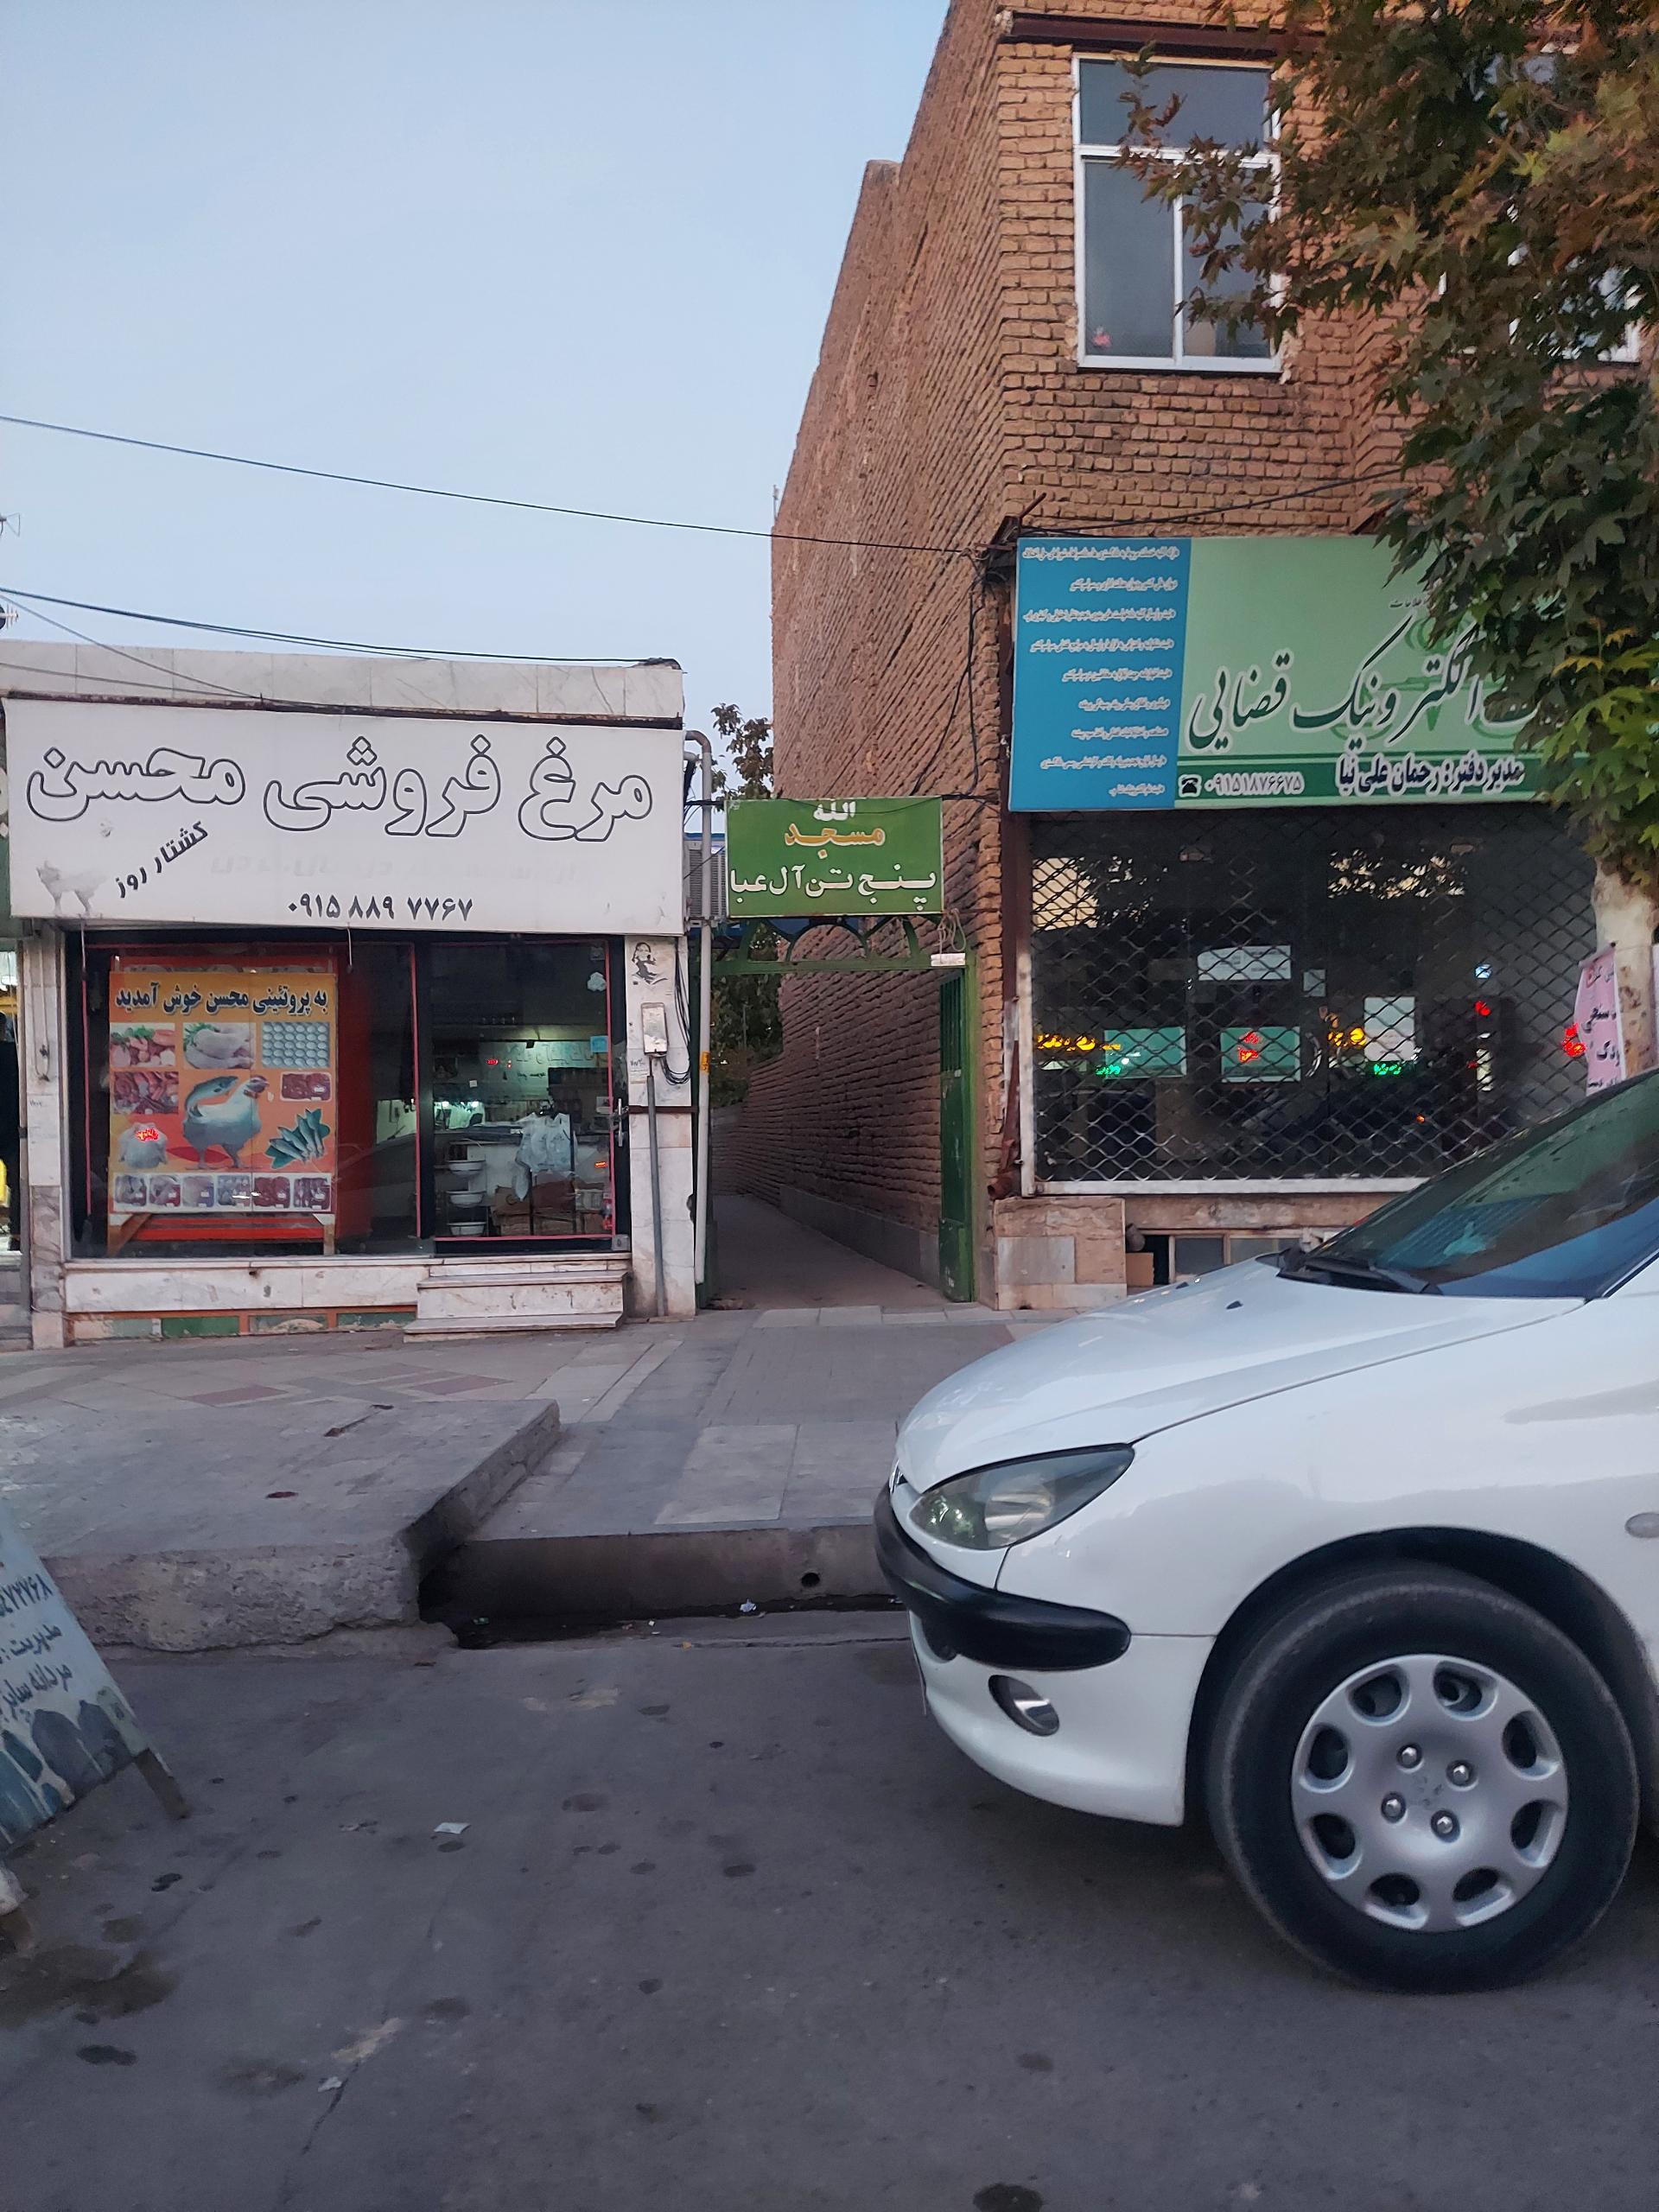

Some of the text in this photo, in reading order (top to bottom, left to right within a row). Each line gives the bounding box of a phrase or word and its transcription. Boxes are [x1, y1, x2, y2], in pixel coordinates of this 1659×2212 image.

[27, 747, 246, 822] محسن
[264, 734, 501, 837] فروشی
[518, 736, 653, 842] مرغ
[1482, 755, 1524, 795] مدیر
[812, 801, 856, 821] الله
[155, 822, 208, 873] کشتار
[784, 823, 886, 859] مسجد
[115, 867, 147, 898] روز
[730, 863, 937, 911] پنج تن آل عبا
[407, 895, 473, 921] ۷۷۶۷
[116, 982, 159, 1012] آمدید
[163, 984, 201, 1016] خوش
[206, 988, 249, 1015] محسن
[314, 989, 328, 1015] به
